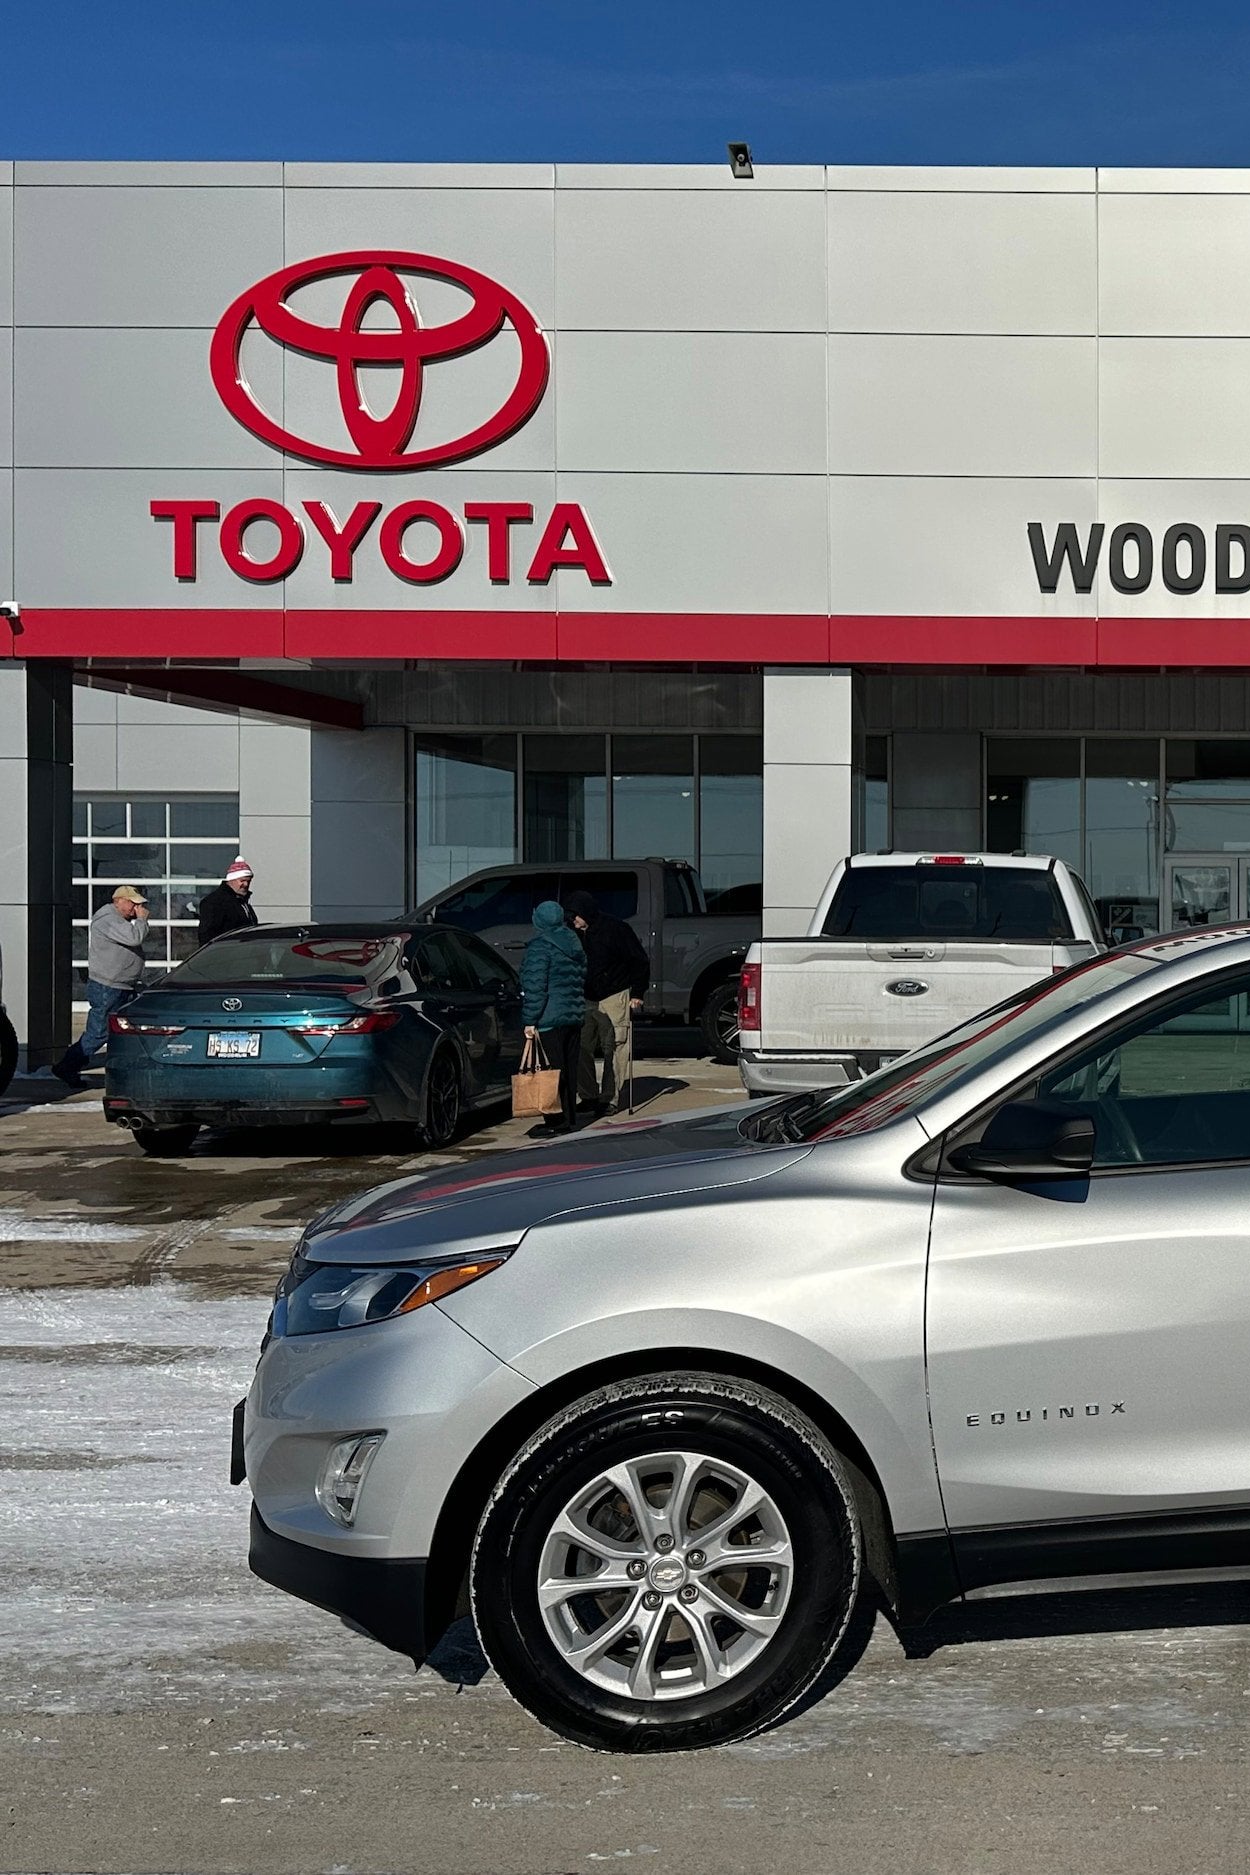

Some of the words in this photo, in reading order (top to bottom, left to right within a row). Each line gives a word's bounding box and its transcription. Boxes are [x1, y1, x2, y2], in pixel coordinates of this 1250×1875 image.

[150, 497, 613, 586] TOYOTA
[895, 982, 919, 993] Ford
[966, 1400, 1126, 1427] EQUINOX
